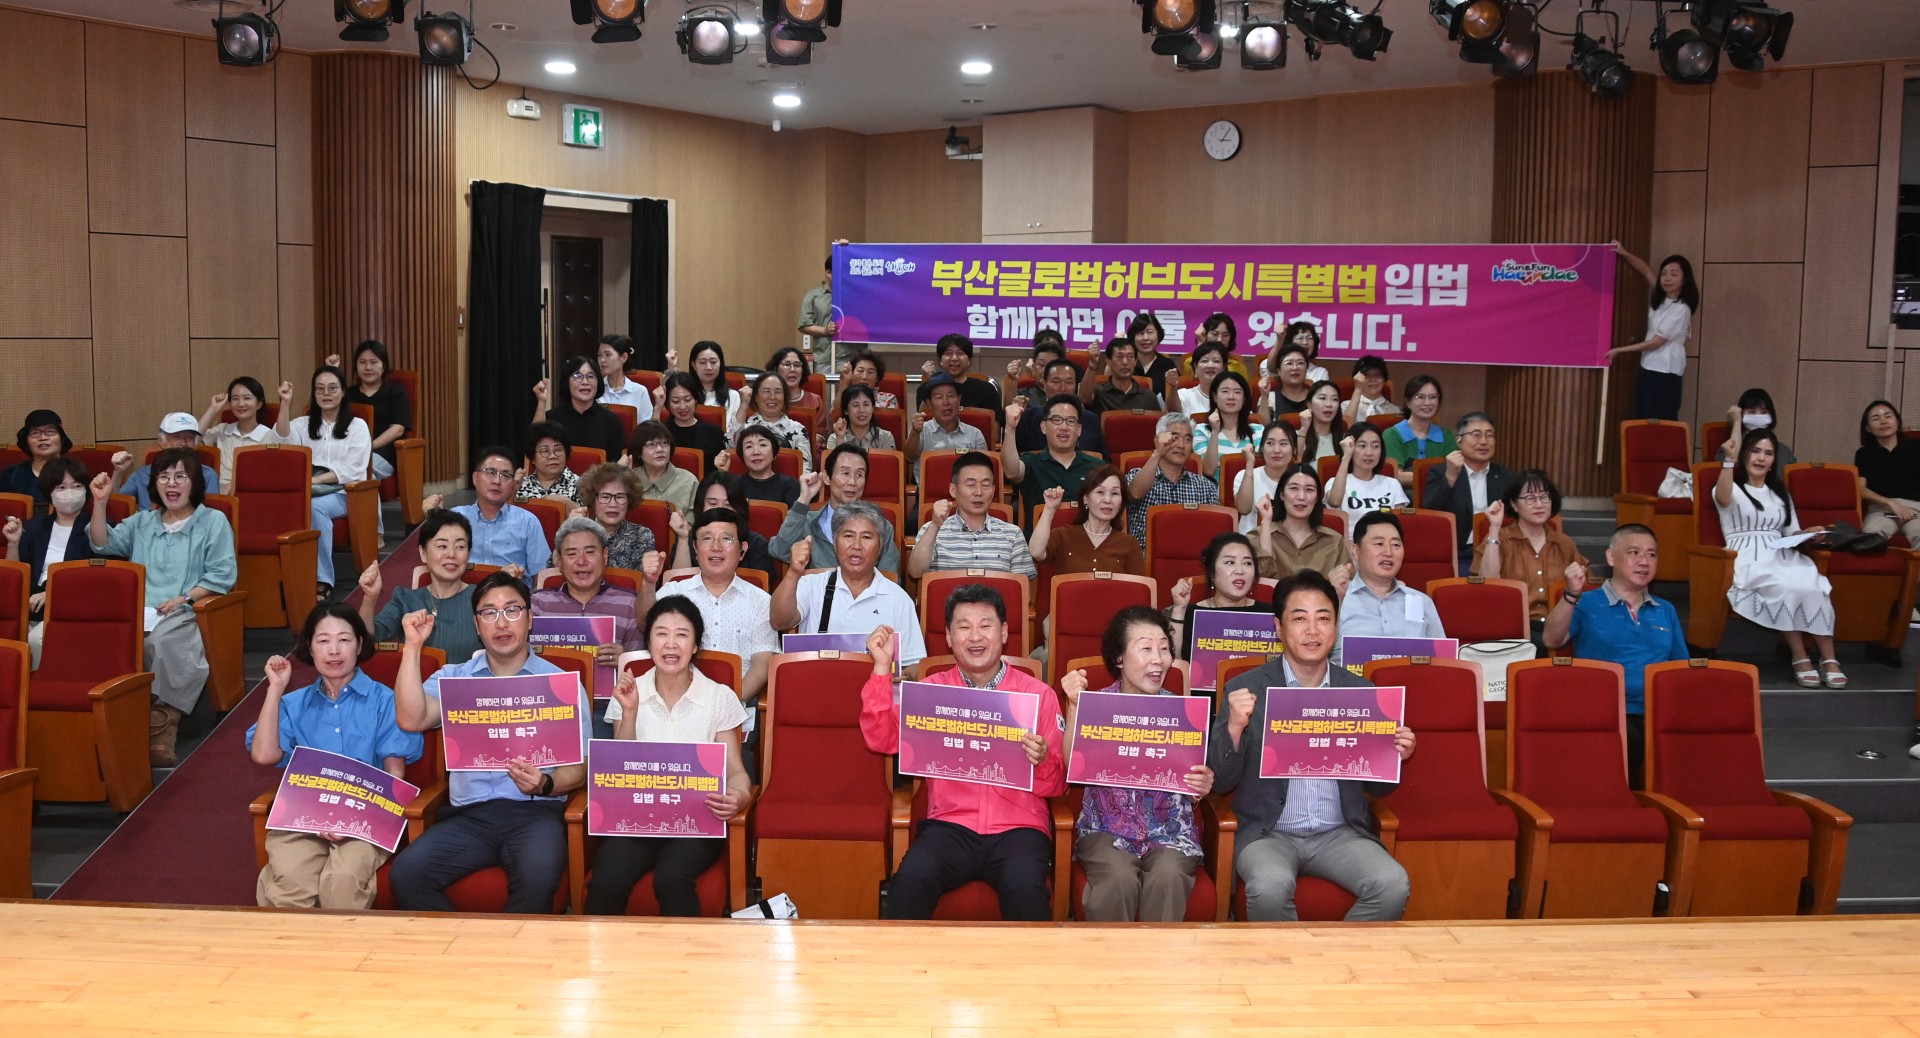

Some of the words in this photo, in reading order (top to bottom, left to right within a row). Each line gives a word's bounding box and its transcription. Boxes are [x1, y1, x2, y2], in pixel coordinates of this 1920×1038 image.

[931, 260, 1377, 303] 부산글로벌허브도시특별법
[1384, 263, 1469, 306] 입법
[966, 303, 1104, 343] 함께하면
[1197, 638, 1284, 653] 부산글로벌허브도시특
[448, 705, 574, 723] 부산글로벌허브도시특별법
[488, 728, 509, 738] 입법
[515, 727, 537, 737] 촉구
[1270, 720, 1396, 734] 부산글로벌허브도시특별법
[1080, 725, 1202, 746] 부산글로벌허브도시특별법
[1309, 738, 1330, 747] 입법
[1336, 738, 1357, 747] 촉구
[944, 737, 964, 749] 입법
[970, 740, 990, 751] 촉구
[1118, 746, 1139, 756] 입법
[1145, 747, 1166, 759] 촉구
[594, 773, 718, 791] 부산글로벌허브도시특별법
[288, 773, 405, 816] 부산글로벌허브도시특별법
[319, 793, 340, 804] 입법
[345, 798, 366, 810] 촉구
[633, 793, 654, 803] 입법
[660, 793, 681, 804] 촉구
